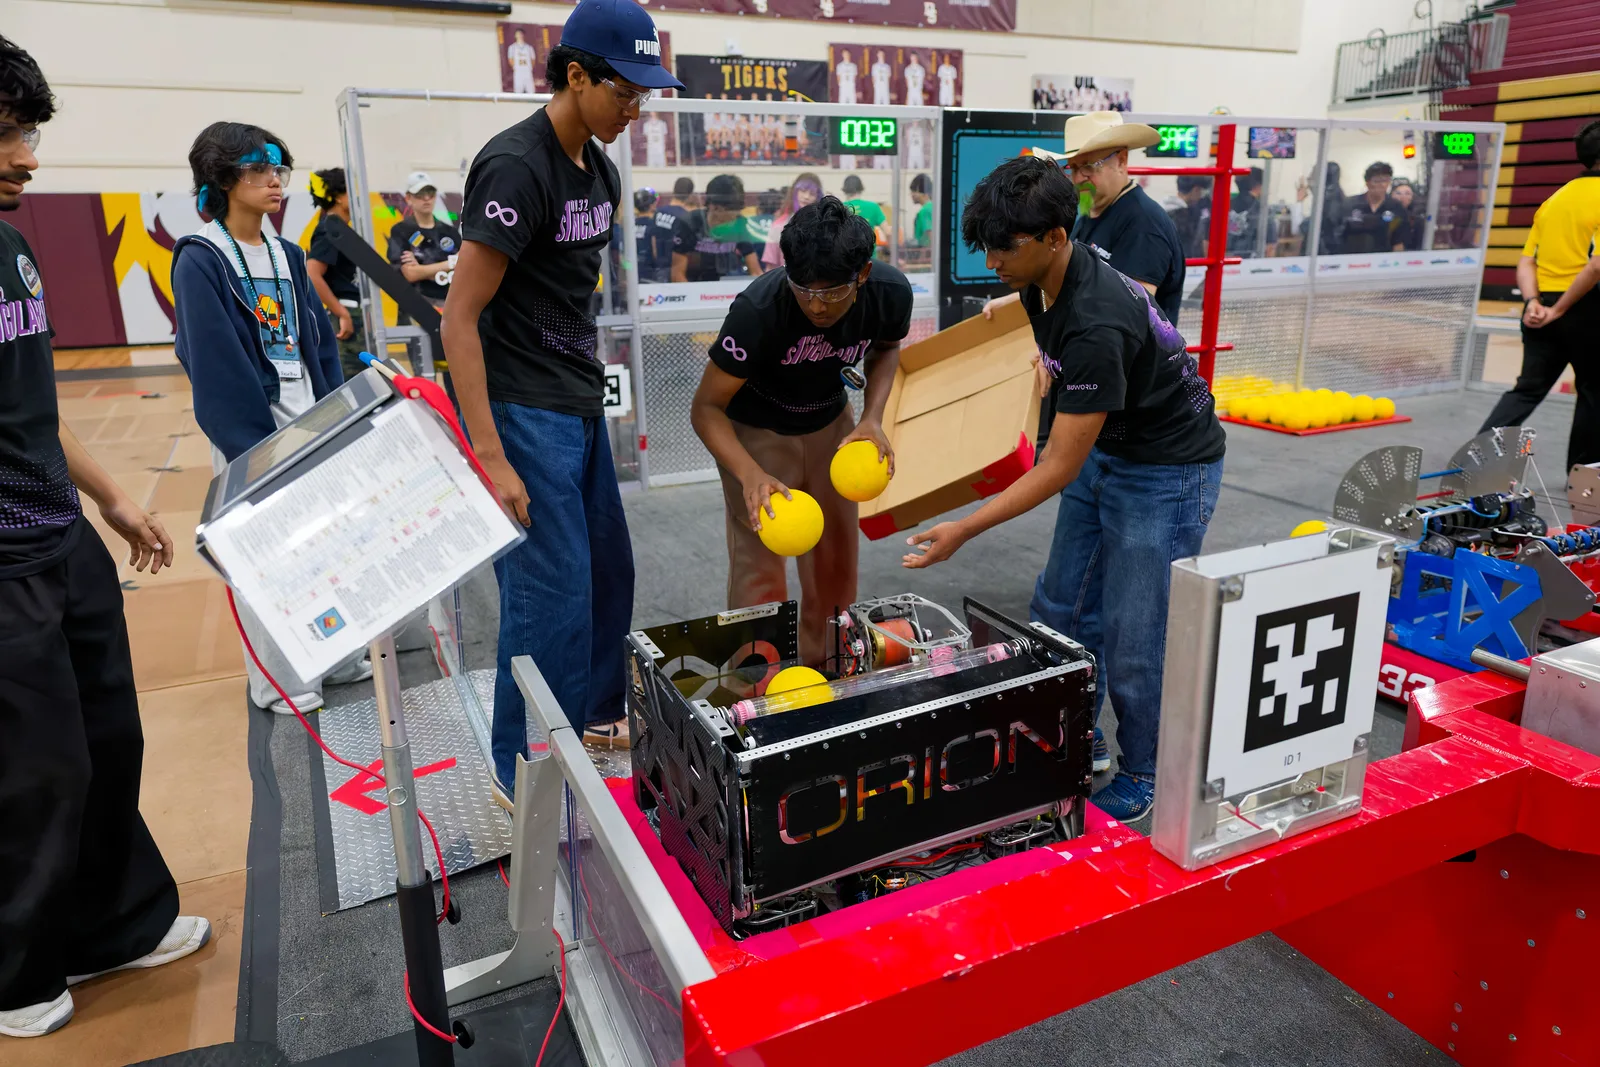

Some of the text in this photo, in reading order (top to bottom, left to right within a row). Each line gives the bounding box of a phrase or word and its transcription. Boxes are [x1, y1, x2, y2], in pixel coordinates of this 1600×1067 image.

[635, 39, 661, 57] PUM
[721, 65, 788, 92] TIGERS
[1157, 126, 1197, 151] SAFE
[1283, 751, 1302, 766] ID 1
[777, 707, 1068, 846] ORION
